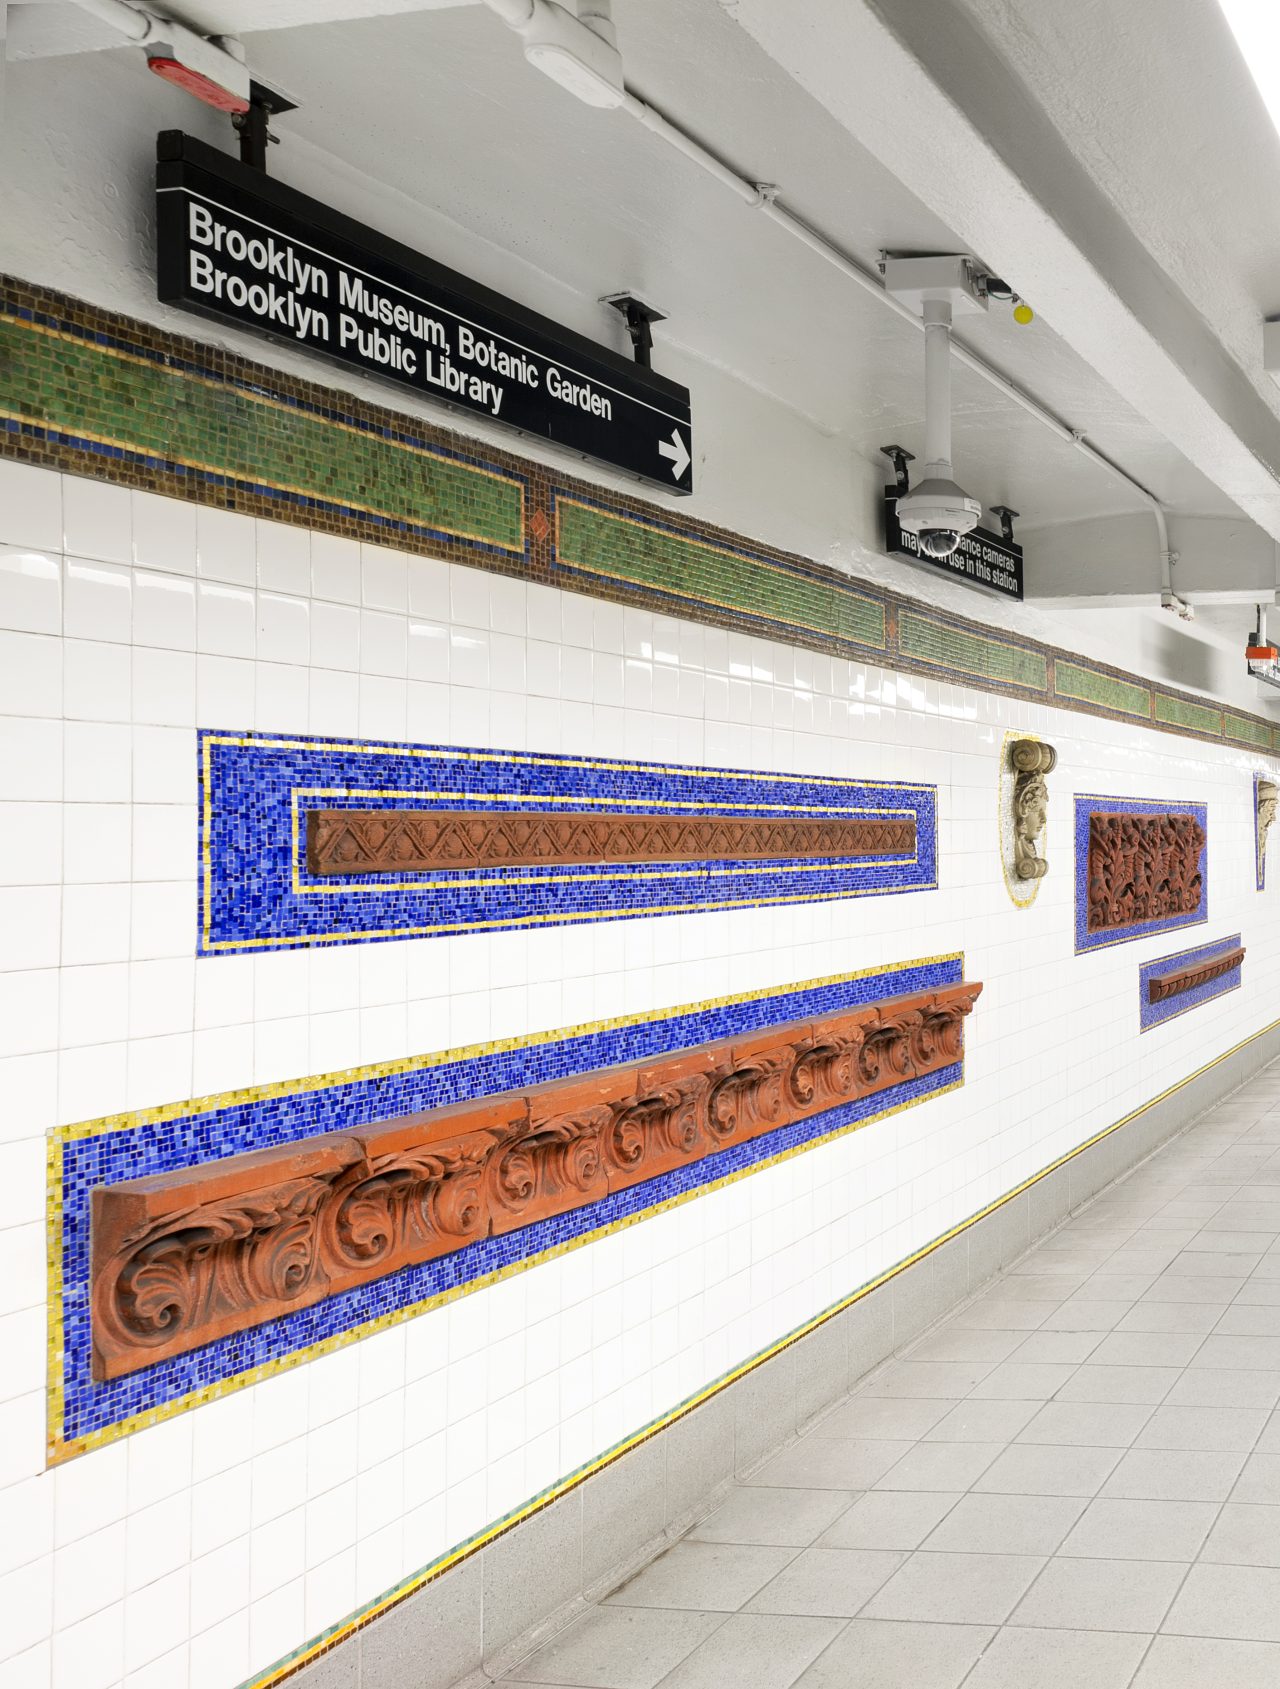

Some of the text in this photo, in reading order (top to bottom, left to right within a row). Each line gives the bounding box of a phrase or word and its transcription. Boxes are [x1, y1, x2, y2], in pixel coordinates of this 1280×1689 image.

[189, 201, 612, 421] Brooklyn Museum, Botanic Garden
[190, 249, 503, 415] Brooklyn Public Library
[949, 552, 965, 571] use
[966, 553, 975, 575] in
[975, 560, 991, 582] this
[992, 568, 1018, 592] station
[982, 546, 1015, 572] cameras
